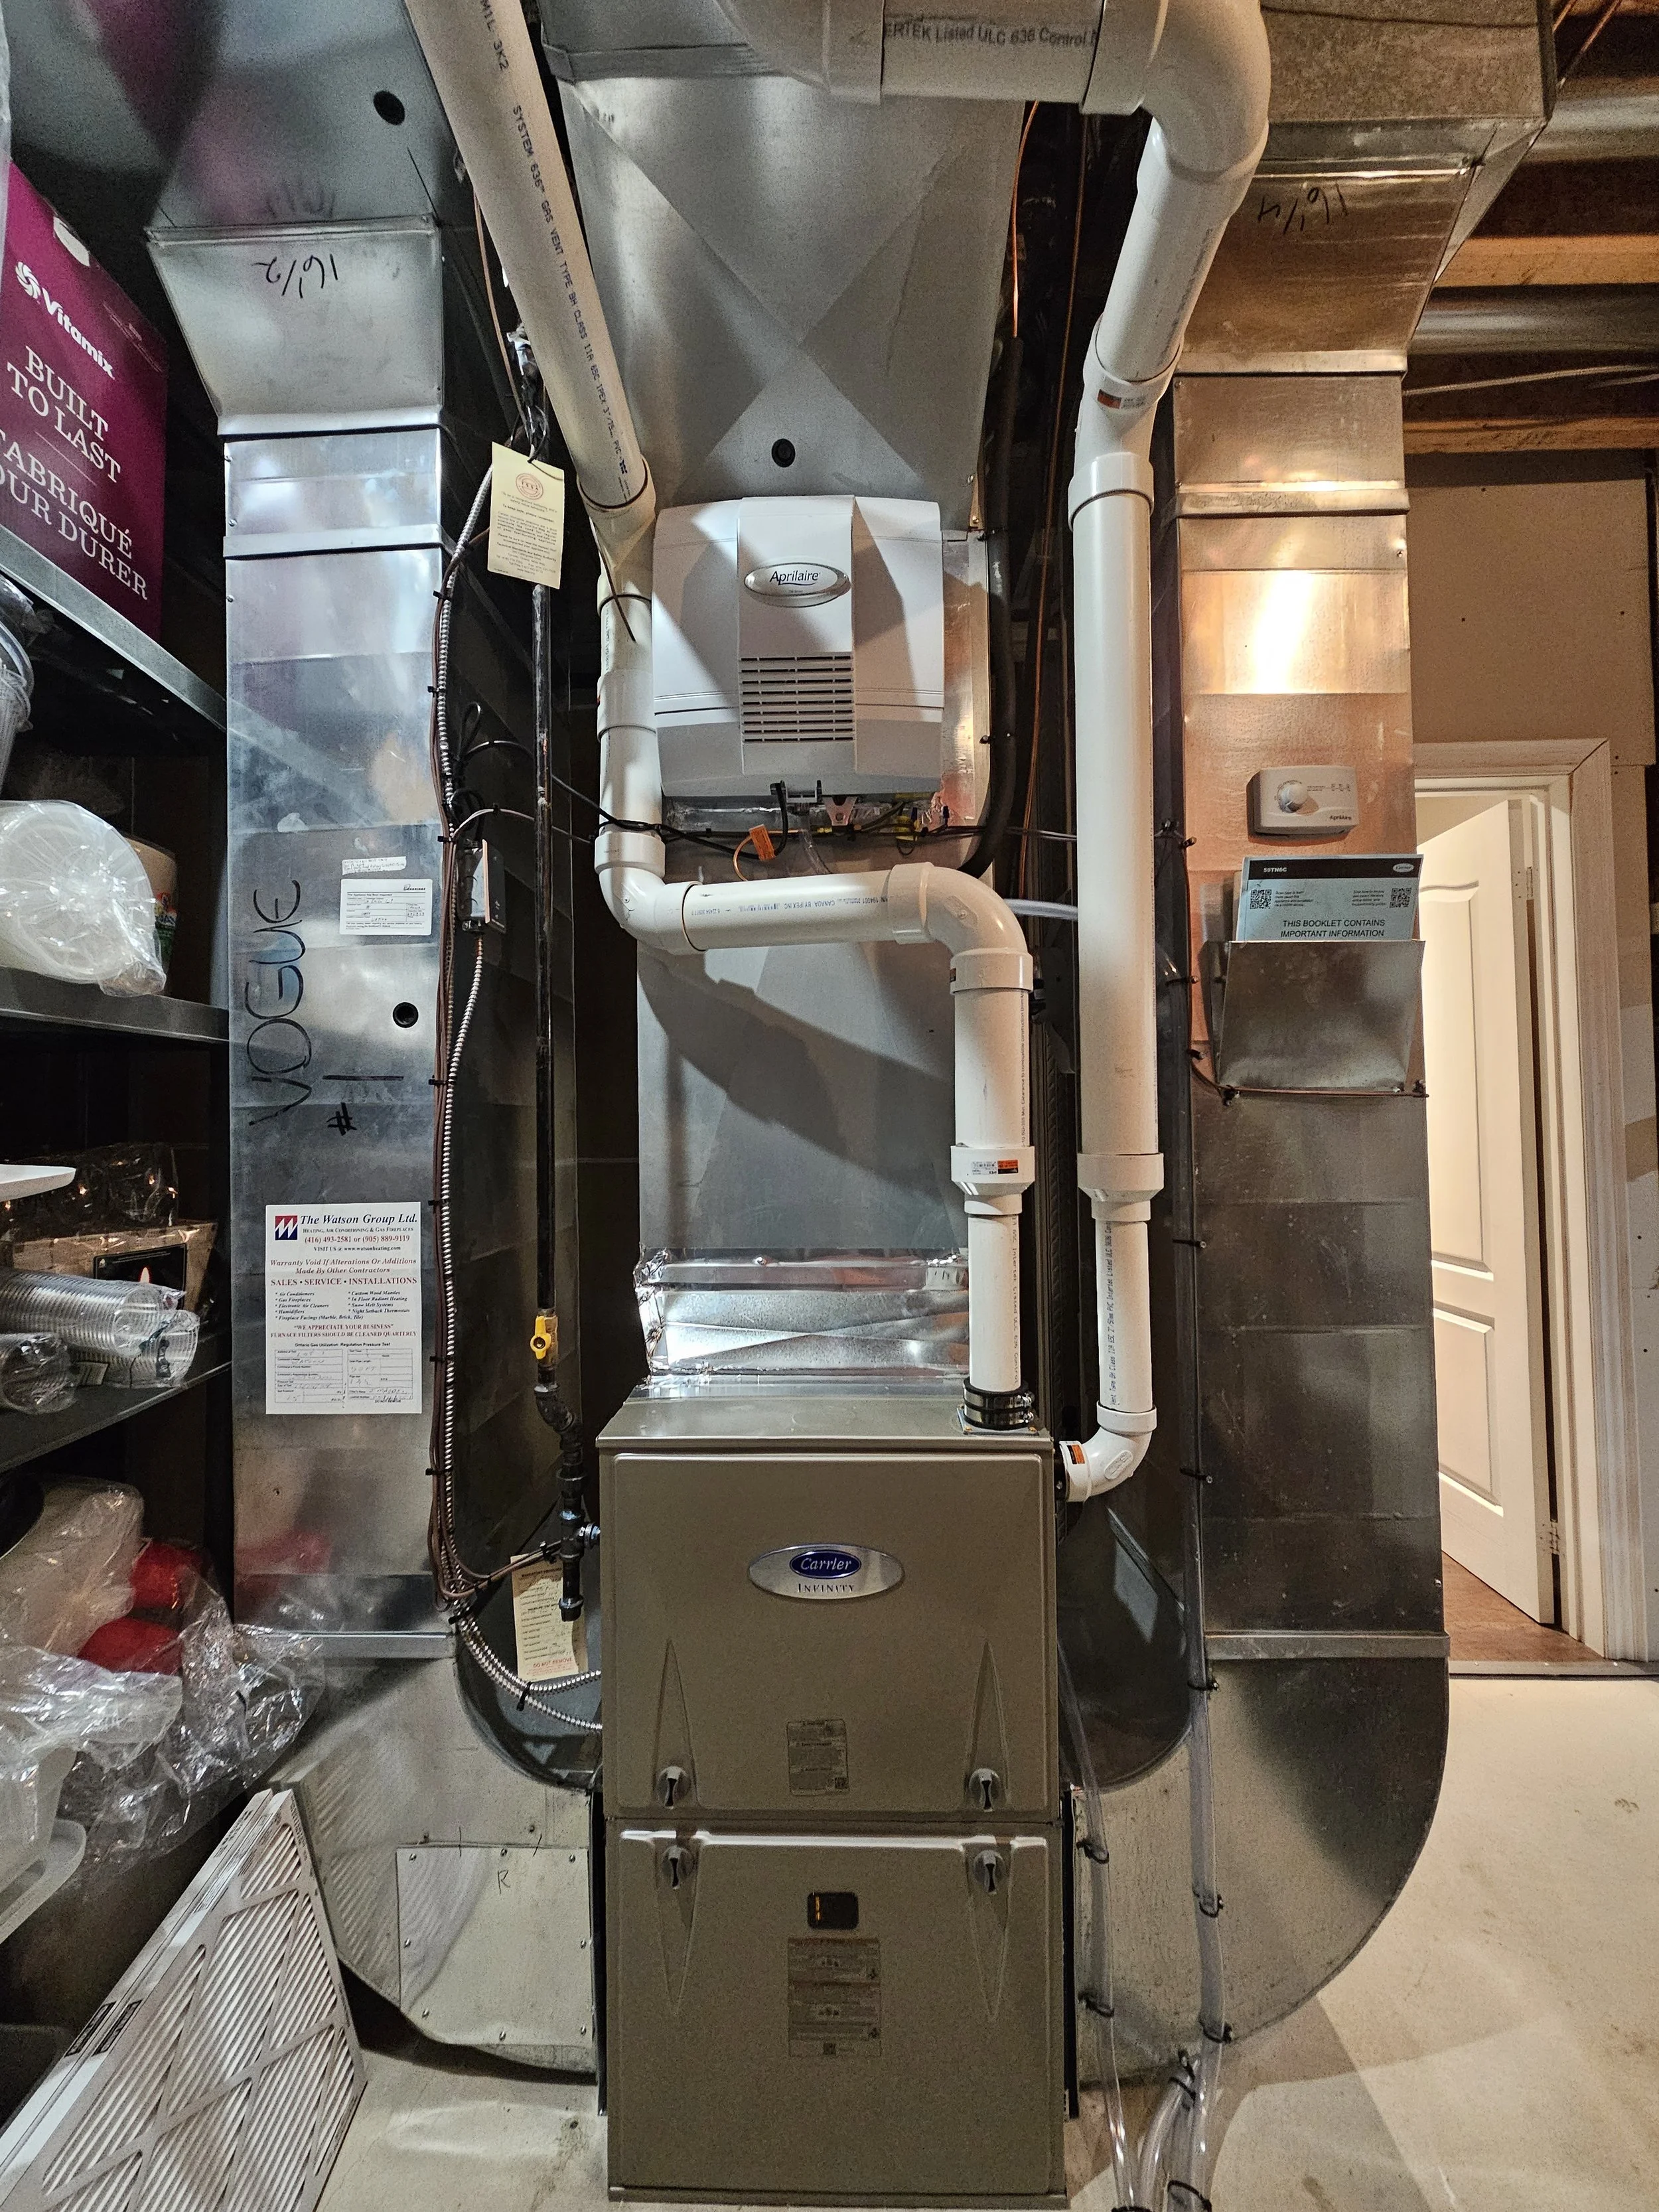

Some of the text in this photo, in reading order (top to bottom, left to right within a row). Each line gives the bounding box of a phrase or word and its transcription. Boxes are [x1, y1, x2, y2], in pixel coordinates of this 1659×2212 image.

[1039, 26, 1086, 46] Control
[513, 104, 534, 157] SYSTEM
[541, 200, 553, 224] GAS
[550, 227, 563, 256] VENT
[559, 261, 574, 289] TYPE
[574, 309, 587, 340] CLASS
[41, 287, 115, 380] Vitamix
[25, 345, 108, 441] BUILT
[7, 361, 121, 484] TO LAST
[58, 511, 147, 601] DURER
[769, 571, 820, 585] Aprilaire
[245, 879, 312, 1126] VOGUE
[301, 1213, 417, 1225] The Watson Group Ltd.
[798, 1583, 855, 1593] INFINITY
[800, 1558, 852, 1570] Carrier
[497, 1869, 511, 1894] R
